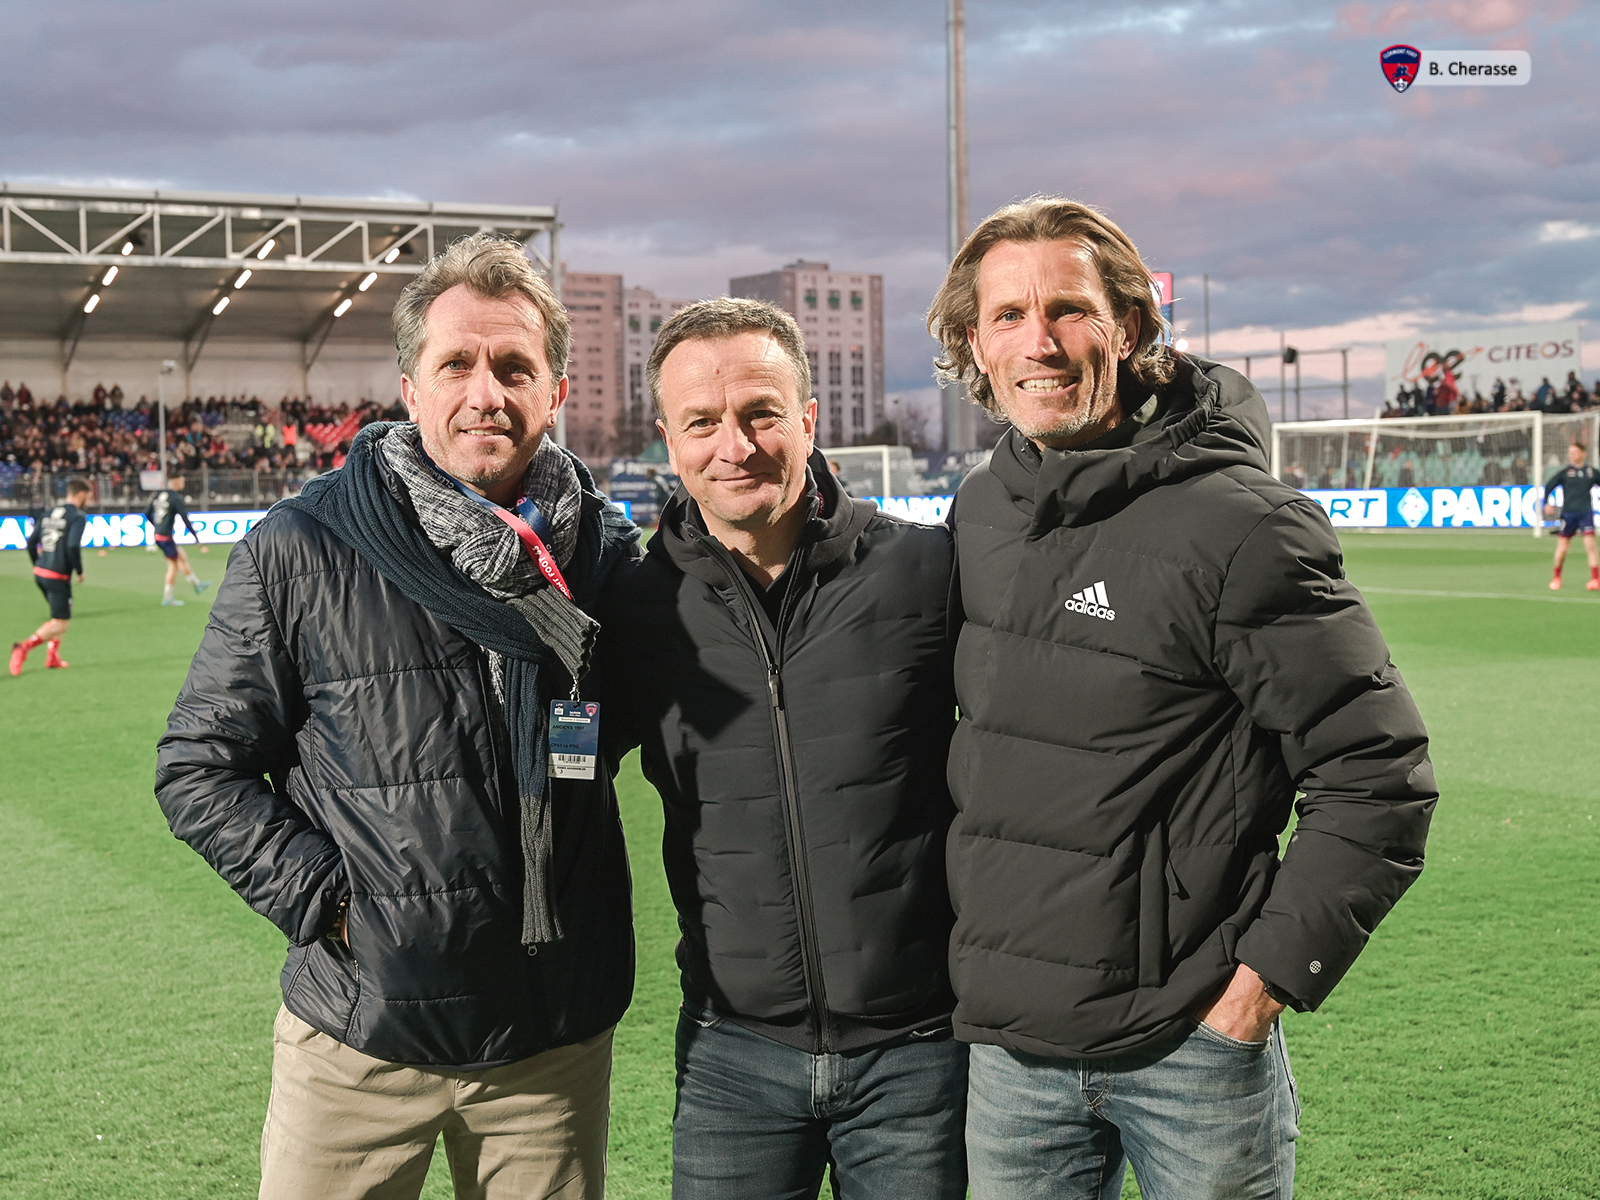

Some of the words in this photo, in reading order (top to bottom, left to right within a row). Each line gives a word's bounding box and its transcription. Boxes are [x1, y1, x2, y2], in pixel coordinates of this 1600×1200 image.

[1488, 338, 1575, 364] CITEOS
[1313, 497, 1380, 519] RT
[1432, 486, 1600, 527] PARI
[538, 556, 555, 577] FOOT
[1064, 599, 1116, 621] adidas
